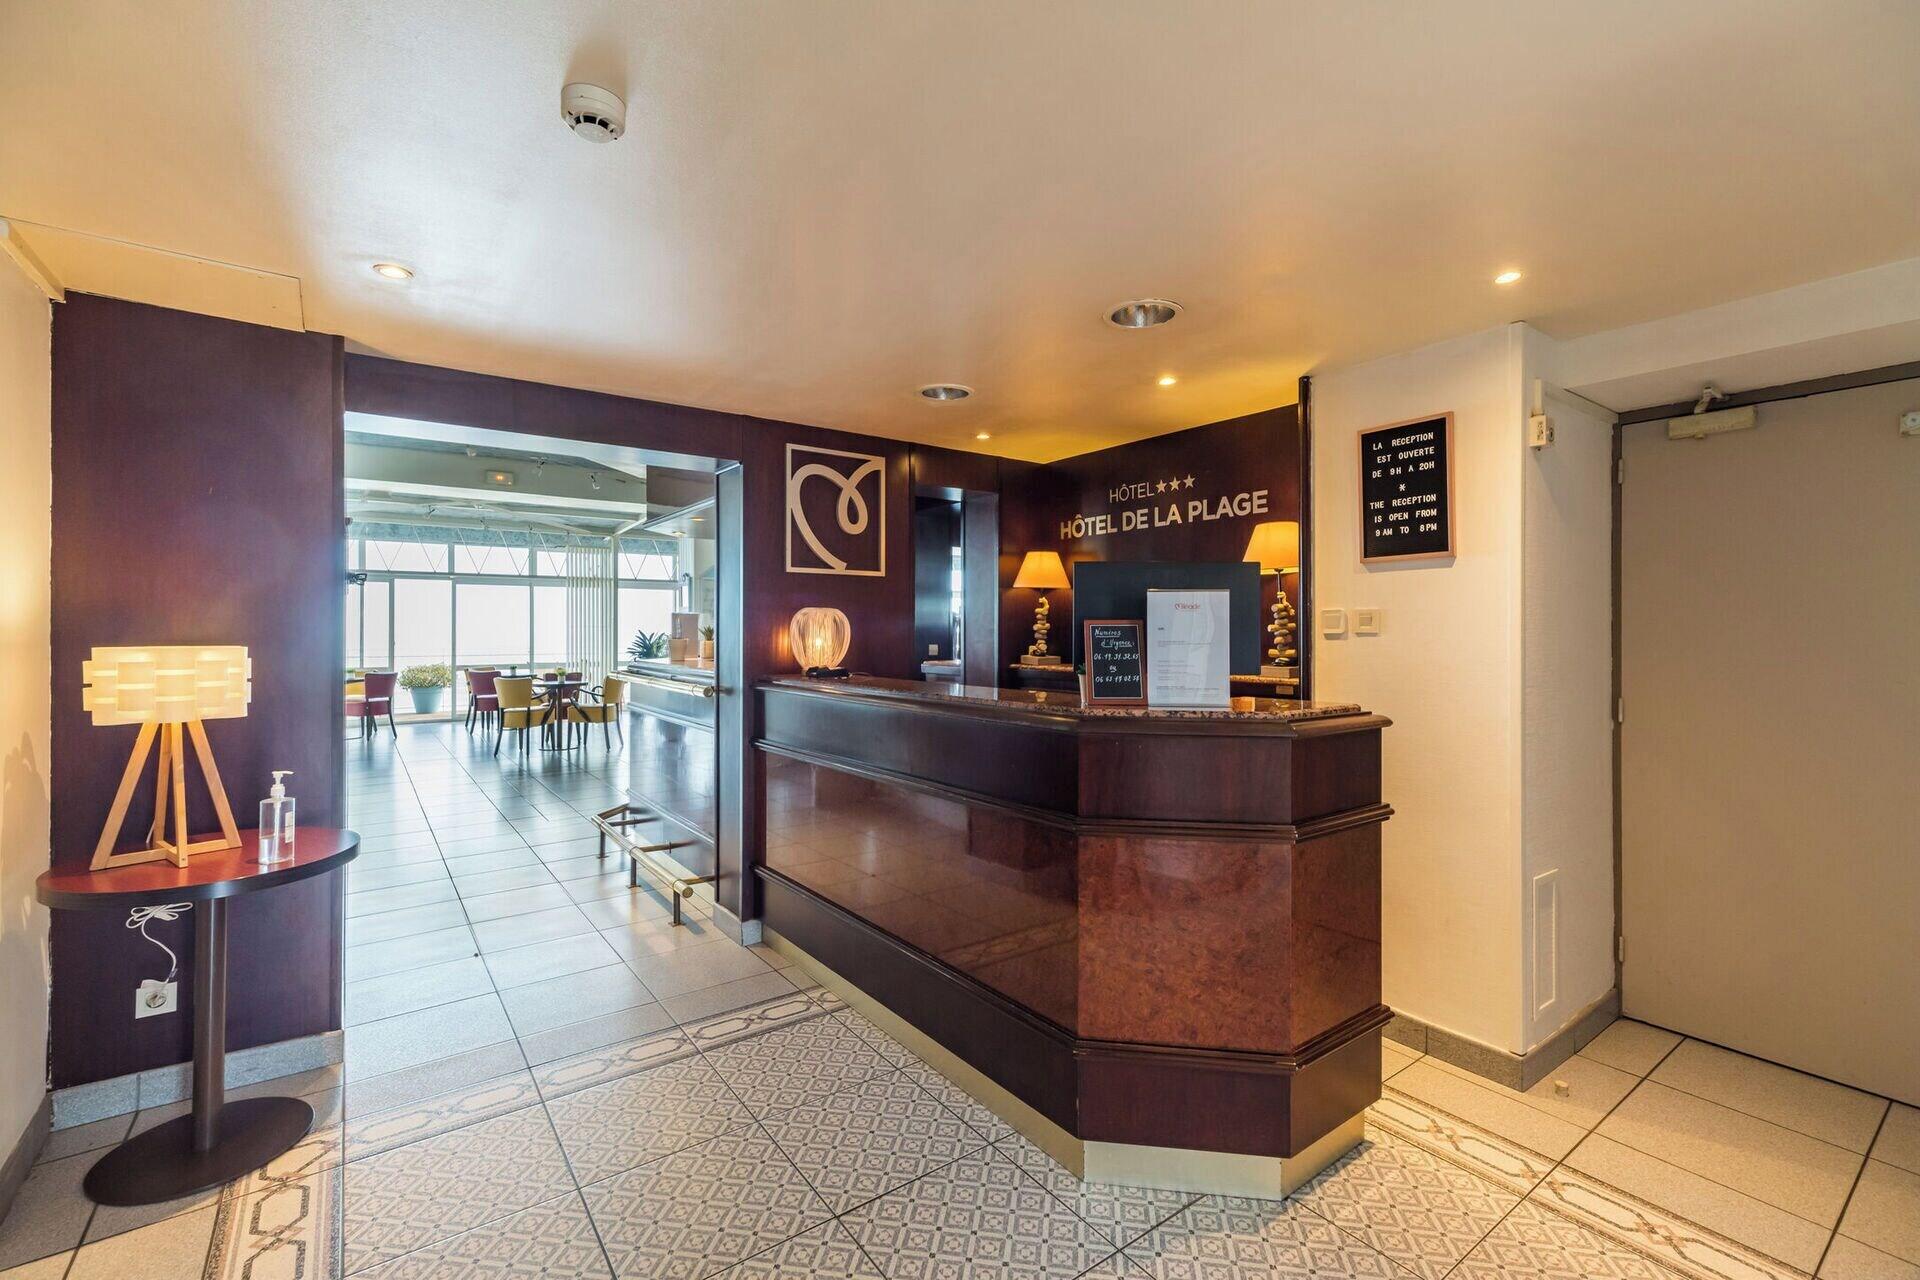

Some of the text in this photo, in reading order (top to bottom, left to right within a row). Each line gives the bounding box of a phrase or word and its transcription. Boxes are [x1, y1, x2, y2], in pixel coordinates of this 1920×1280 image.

[1373, 432, 1434, 450] LA RECEPTION
[1377, 447, 1435, 463] EST OUVERTE
[1372, 470, 1382, 478] DE
[1390, 467, 1401, 475] 9H
[1419, 461, 1435, 471] 20H
[1109, 482, 1154, 503] HÔTEL
[1370, 494, 1436, 509] THE RECEPTION
[1060, 490, 1269, 540] HÔTEL DE LA PLAGE
[1389, 512, 1408, 521] OPEN
[1416, 509, 1437, 518] FROM
[1400, 526, 1409, 534] TO
